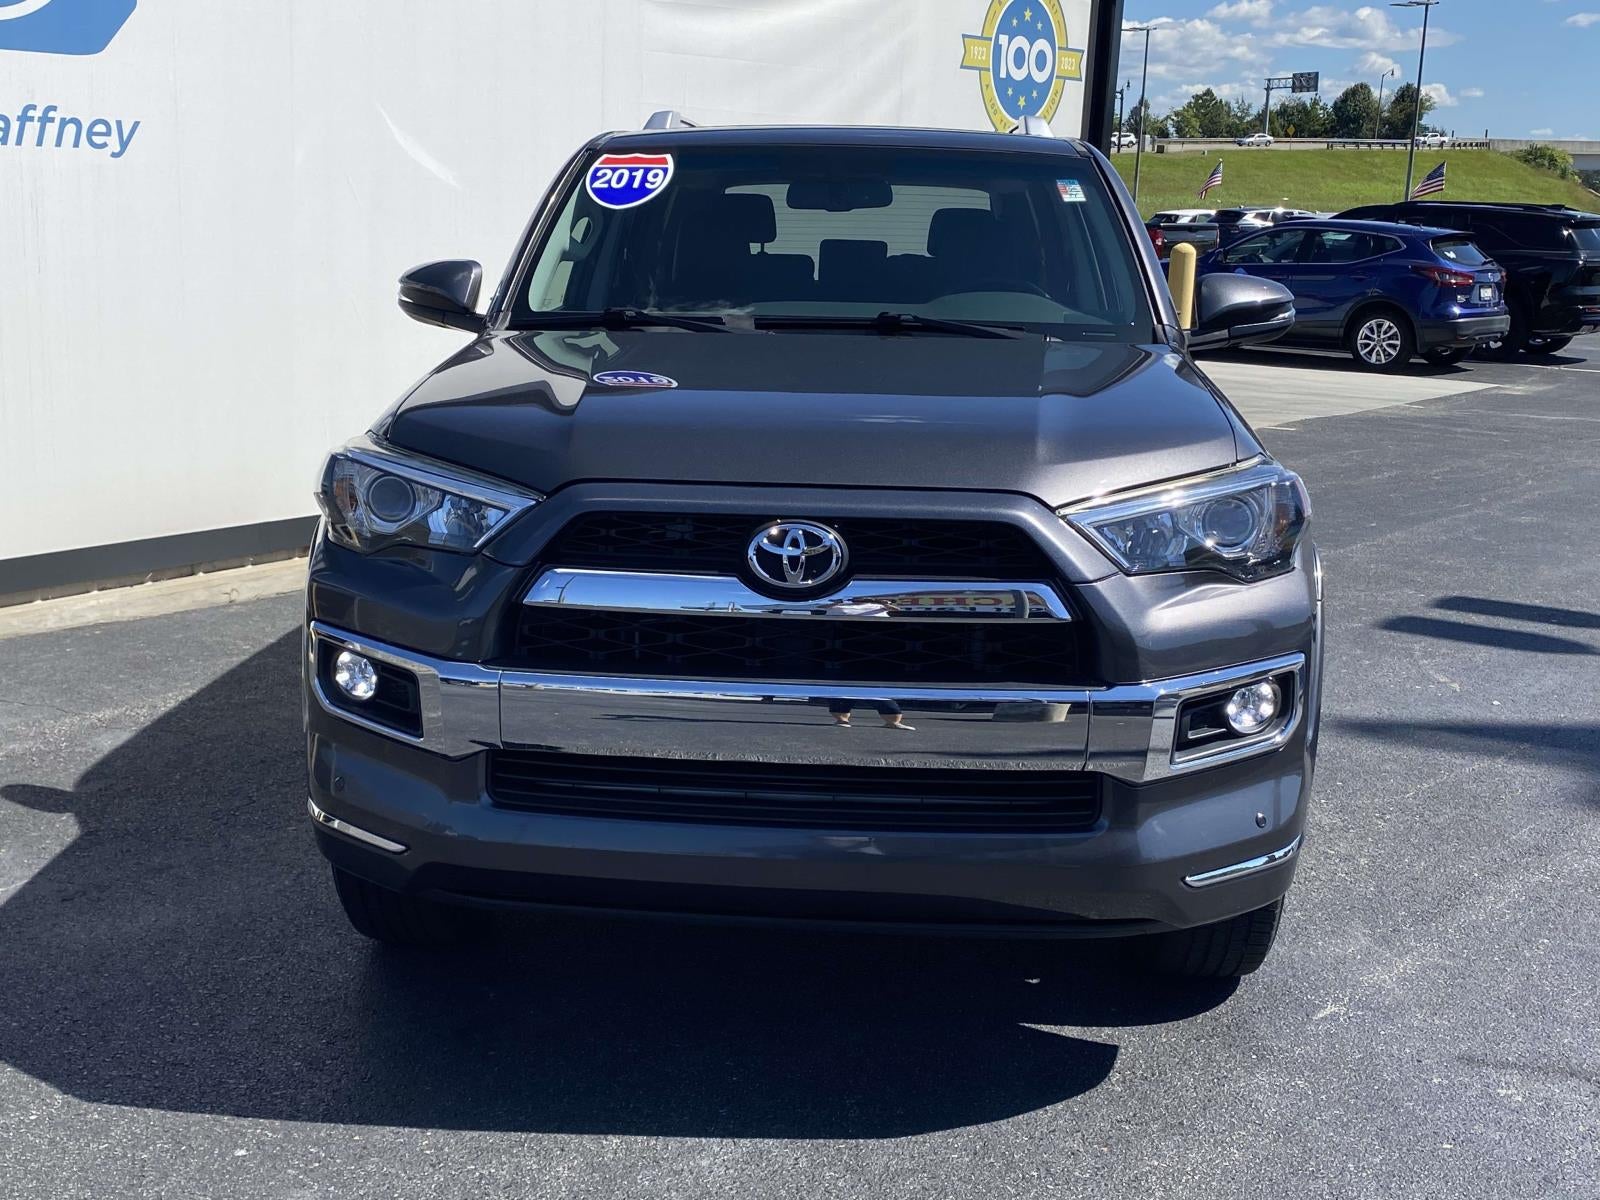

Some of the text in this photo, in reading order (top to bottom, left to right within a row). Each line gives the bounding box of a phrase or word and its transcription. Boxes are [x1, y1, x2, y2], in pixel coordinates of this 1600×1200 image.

[970, 45, 986, 61] 1923
[998, 34, 1053, 83] 100
[1061, 56, 1076, 71] 2023
[592, 169, 664, 189] 2019
